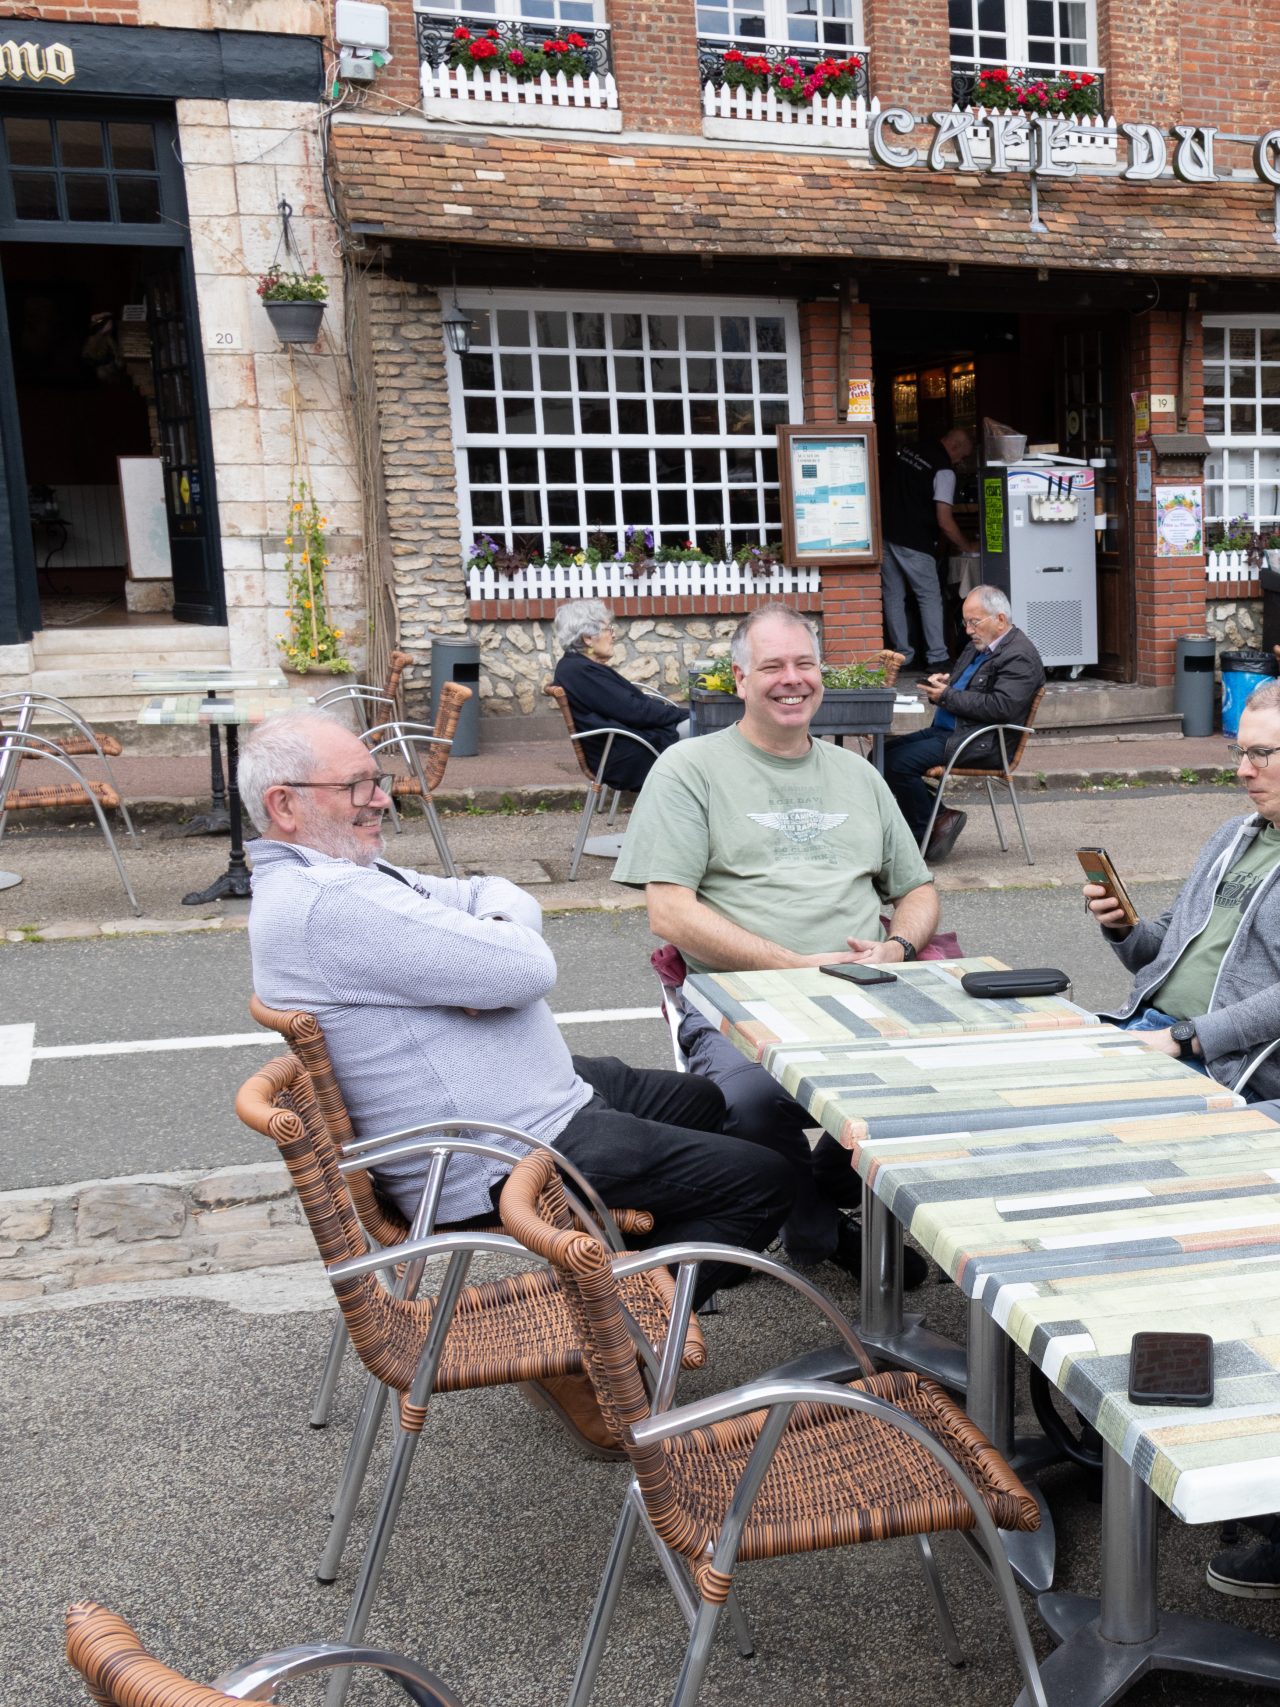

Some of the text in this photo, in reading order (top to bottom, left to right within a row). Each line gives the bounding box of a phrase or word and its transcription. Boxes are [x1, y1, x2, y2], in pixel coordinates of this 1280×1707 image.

[1117, 123, 1220, 183] DU
[215, 332, 234, 345] 20
[1157, 398, 1168, 408] 19
